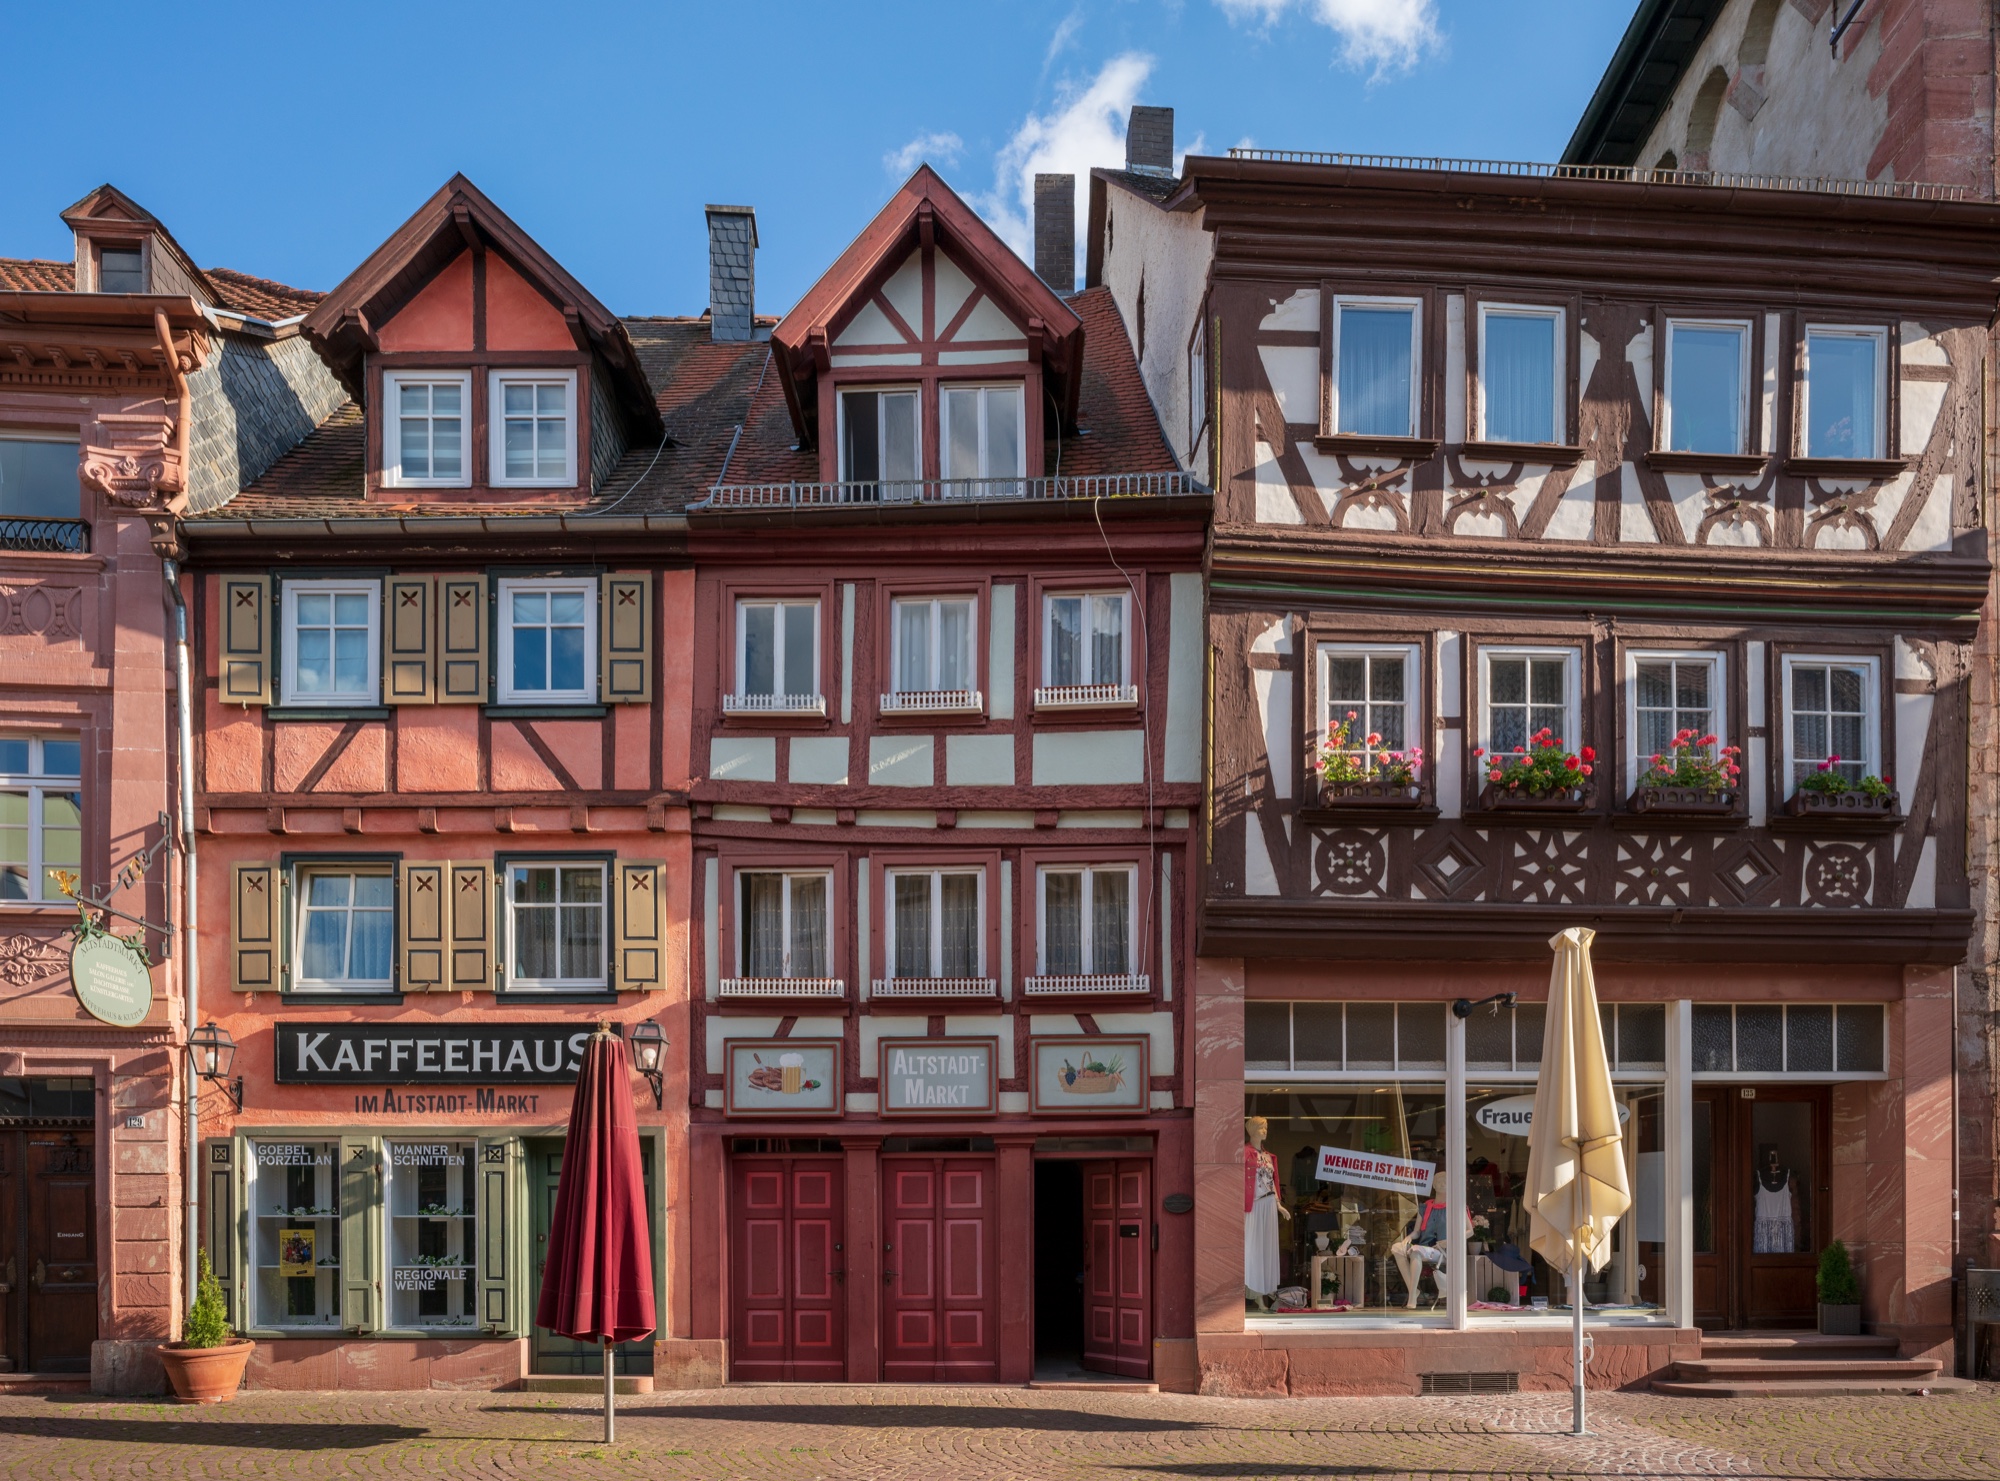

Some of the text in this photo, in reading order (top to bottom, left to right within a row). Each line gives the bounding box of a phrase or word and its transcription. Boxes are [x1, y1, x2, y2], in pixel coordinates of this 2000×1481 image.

[80, 939, 144, 975] ALTSTADTMARKT
[123, 1007, 144, 1020] KULTUR
[296, 1032, 590, 1072] KAFFEEHAUS
[893, 1049, 985, 1075] ALTSTADT-
[905, 1078, 969, 1104] MARKT
[355, 1095, 378, 1113] IM
[129, 1117, 143, 1127] 129
[1482, 1108, 1533, 1124] Fraue
[258, 1145, 309, 1155] GOEBEL
[394, 1145, 448, 1155] MANNER
[258, 1155, 332, 1166] PORZELLAN
[393, 1155, 465, 1166] SCHNITTEN
[1324, 1154, 1429, 1181] WENIGER IST MEHR!
[1342, 1170, 1363, 1179] Planung
[394, 1270, 467, 1280] REGIONALE
[394, 1280, 436, 1290] WEINE
